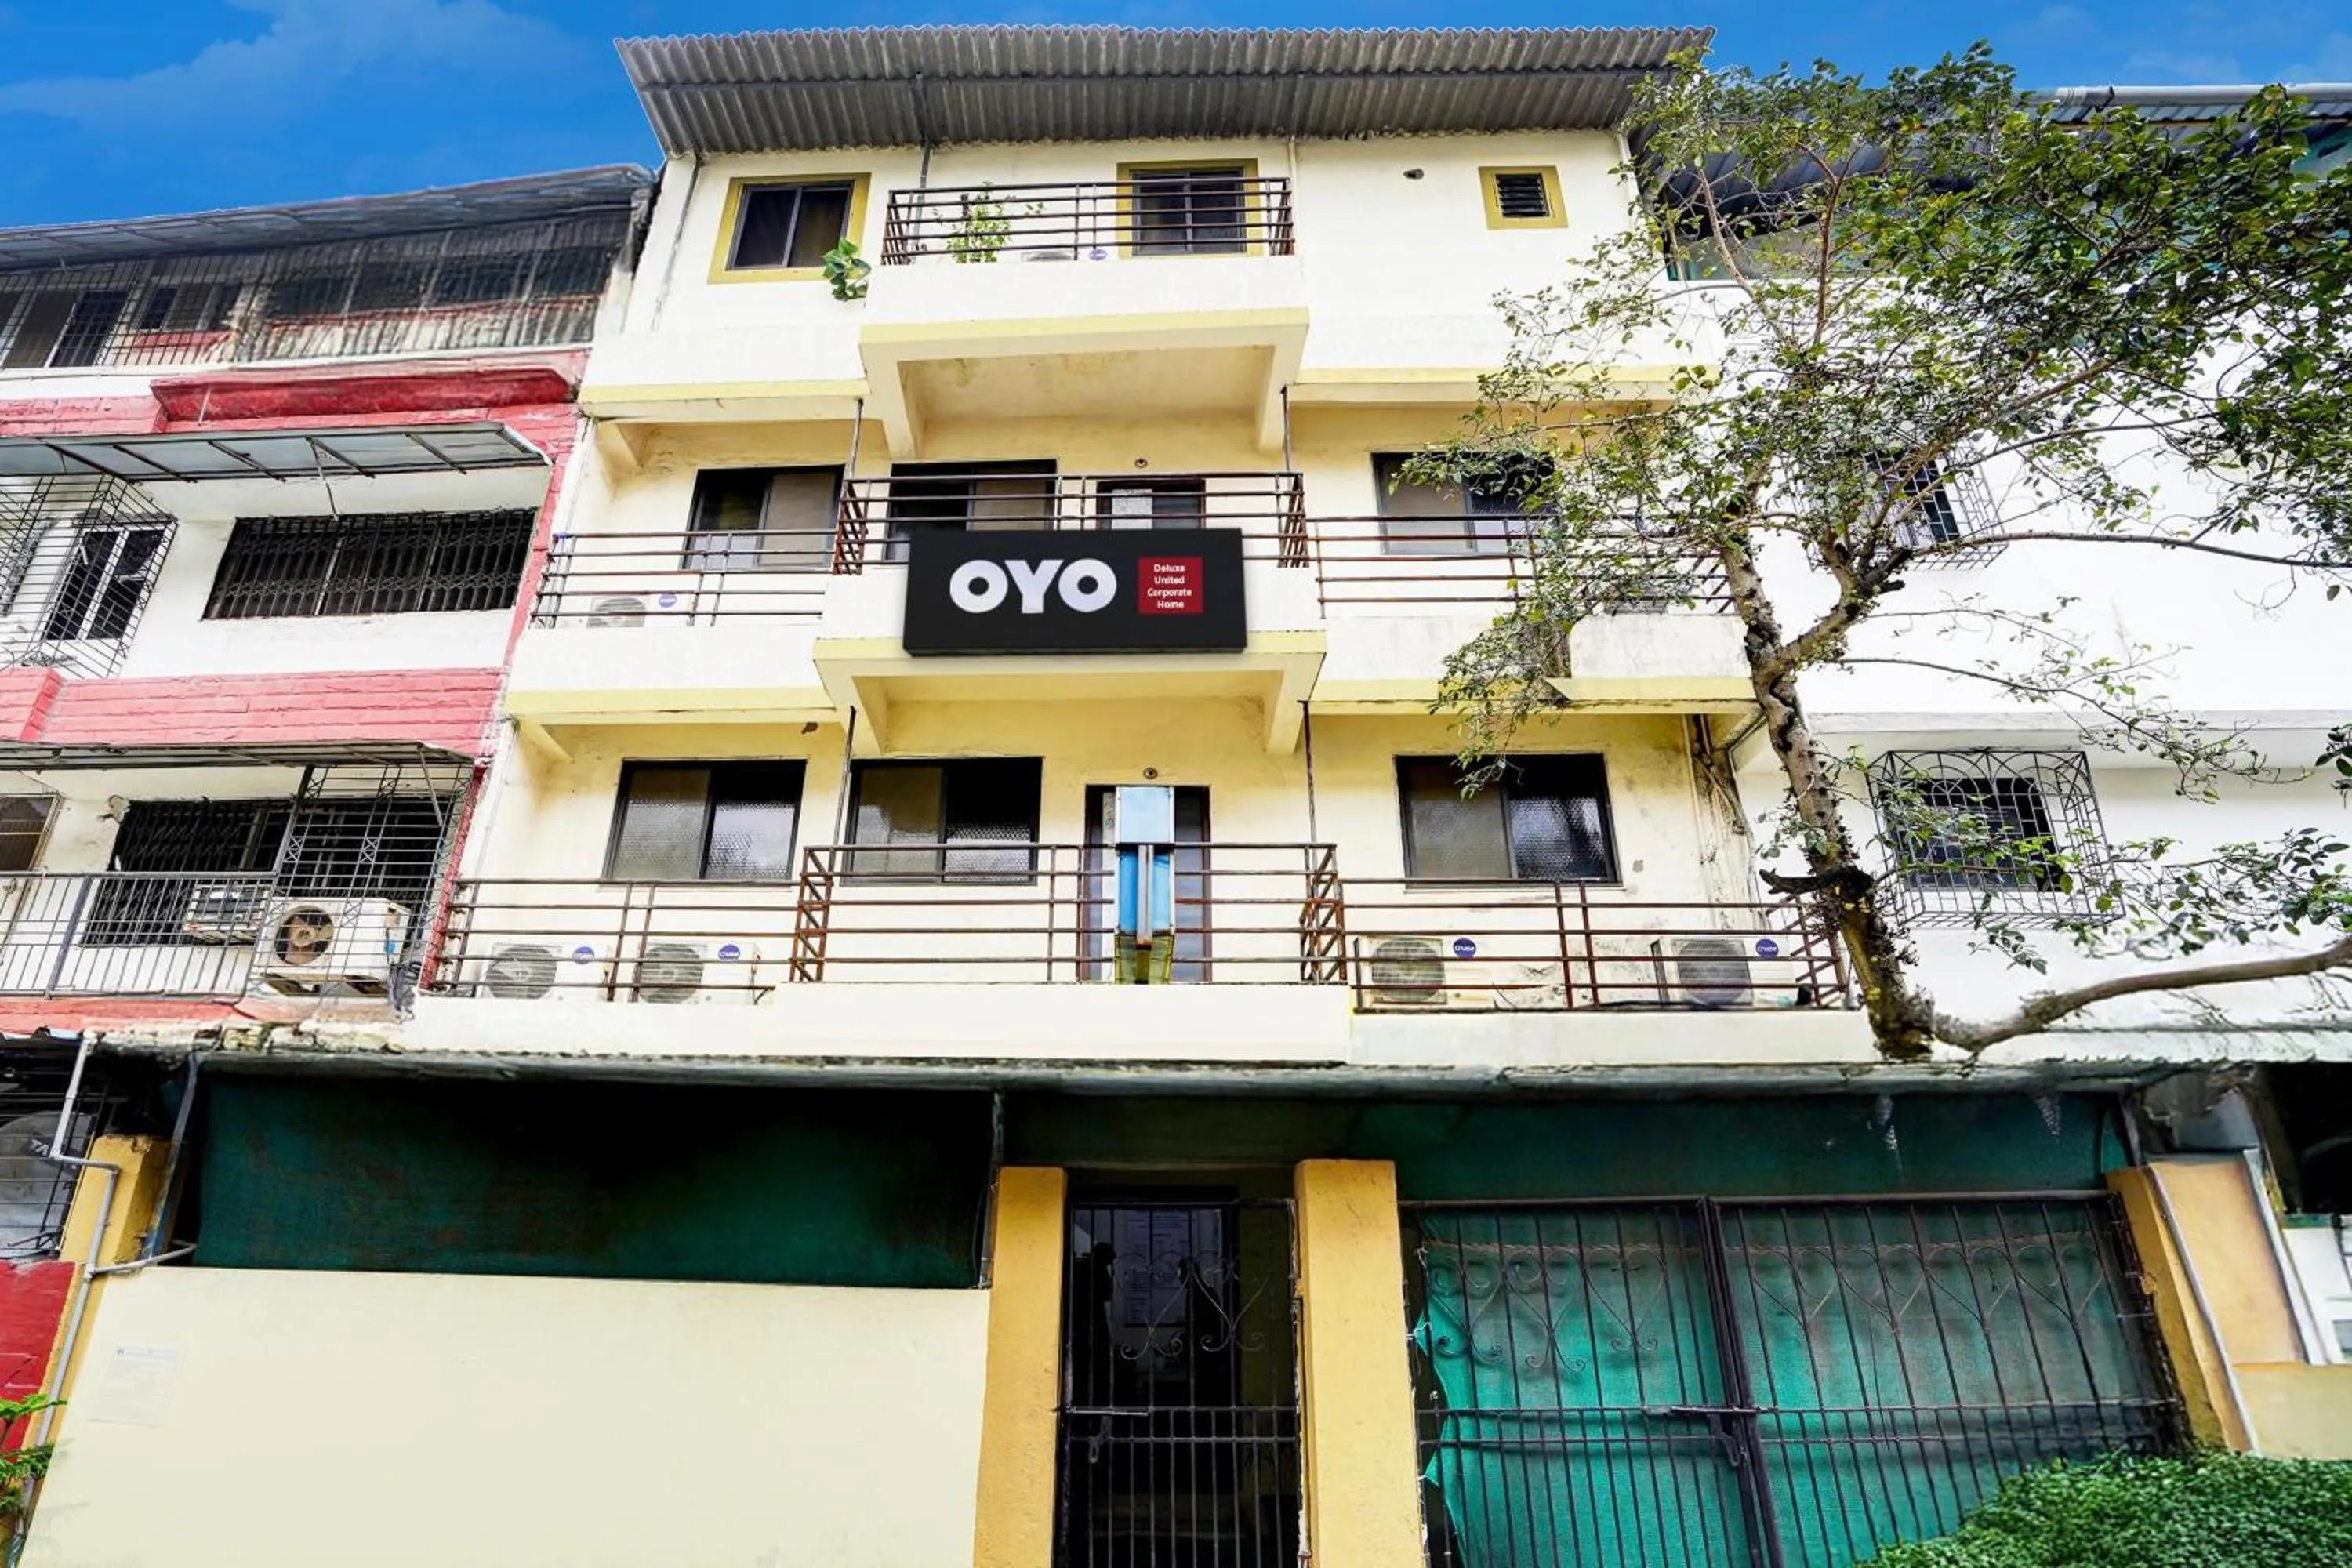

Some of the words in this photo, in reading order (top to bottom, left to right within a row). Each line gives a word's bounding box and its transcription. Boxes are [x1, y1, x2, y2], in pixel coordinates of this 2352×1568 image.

[1153, 564, 1186, 573] Deluxe
[1153, 575, 1185, 585] United
[949, 558, 1117, 614] OYO
[1147, 587, 1192, 598] Corporate
[1156, 600, 1185, 609] Home
